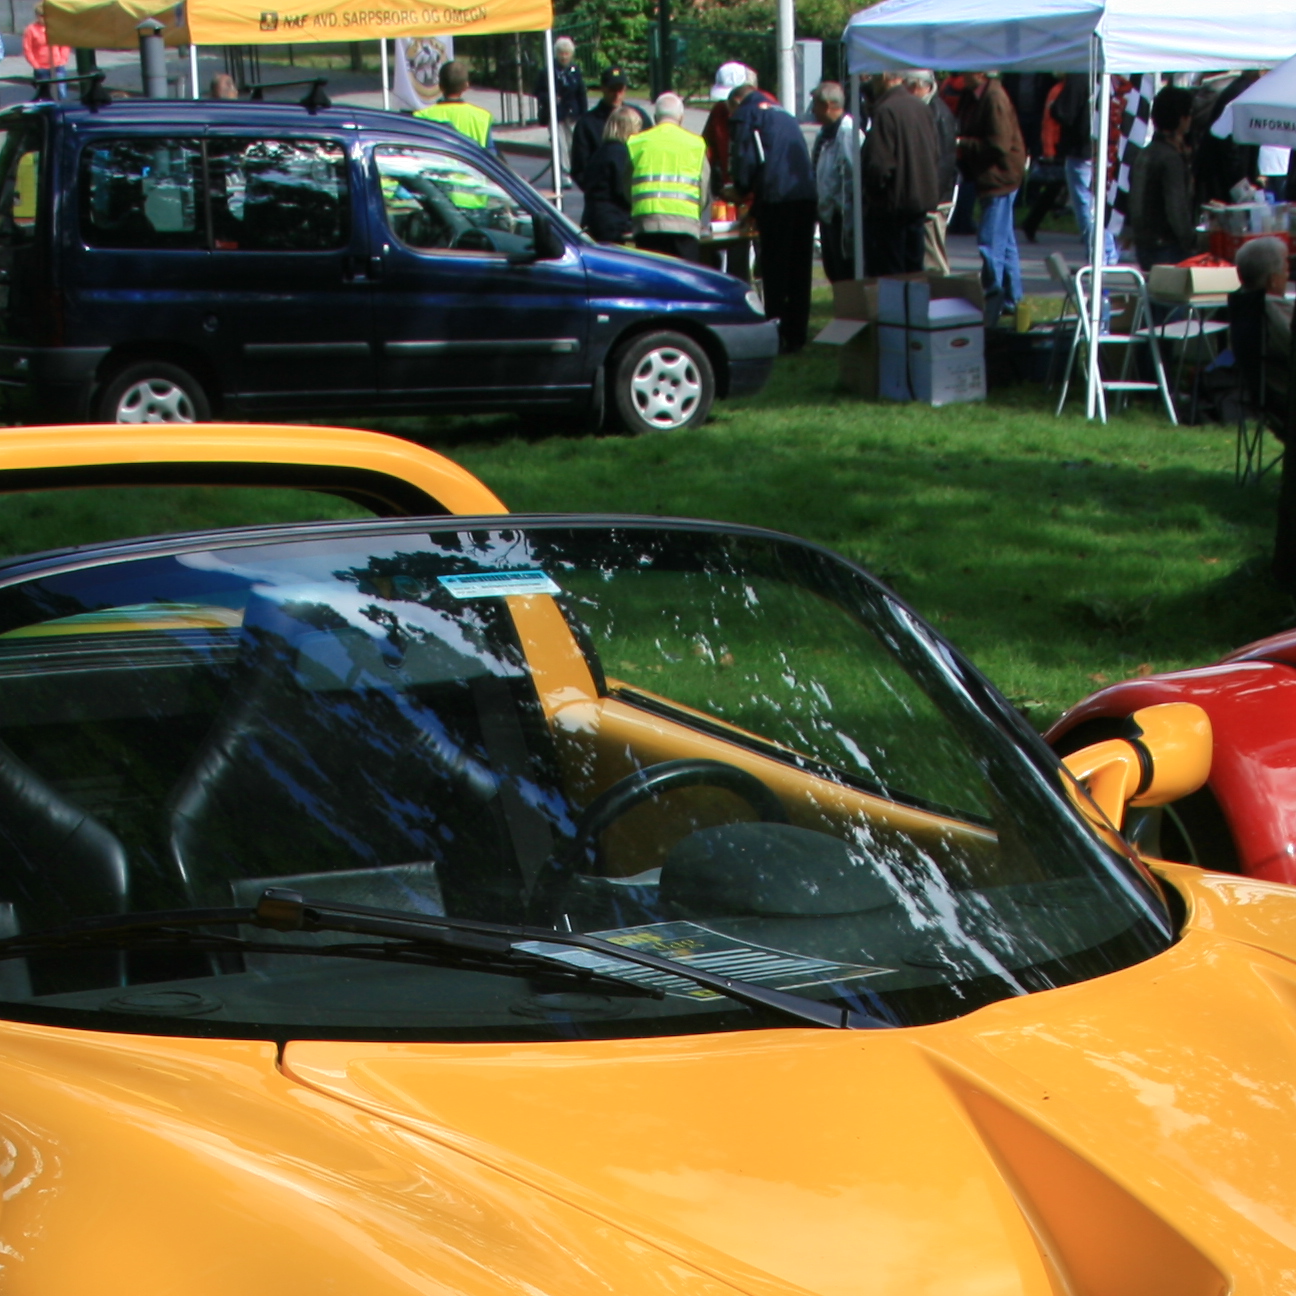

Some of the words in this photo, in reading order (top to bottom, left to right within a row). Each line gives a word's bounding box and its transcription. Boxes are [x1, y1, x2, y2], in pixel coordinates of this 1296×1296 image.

[283, 14, 308, 29] NAF
[313, 12, 341, 27] AVD.
[342, 10, 418, 27] SARPSBORG
[421, 9, 440, 23] OG
